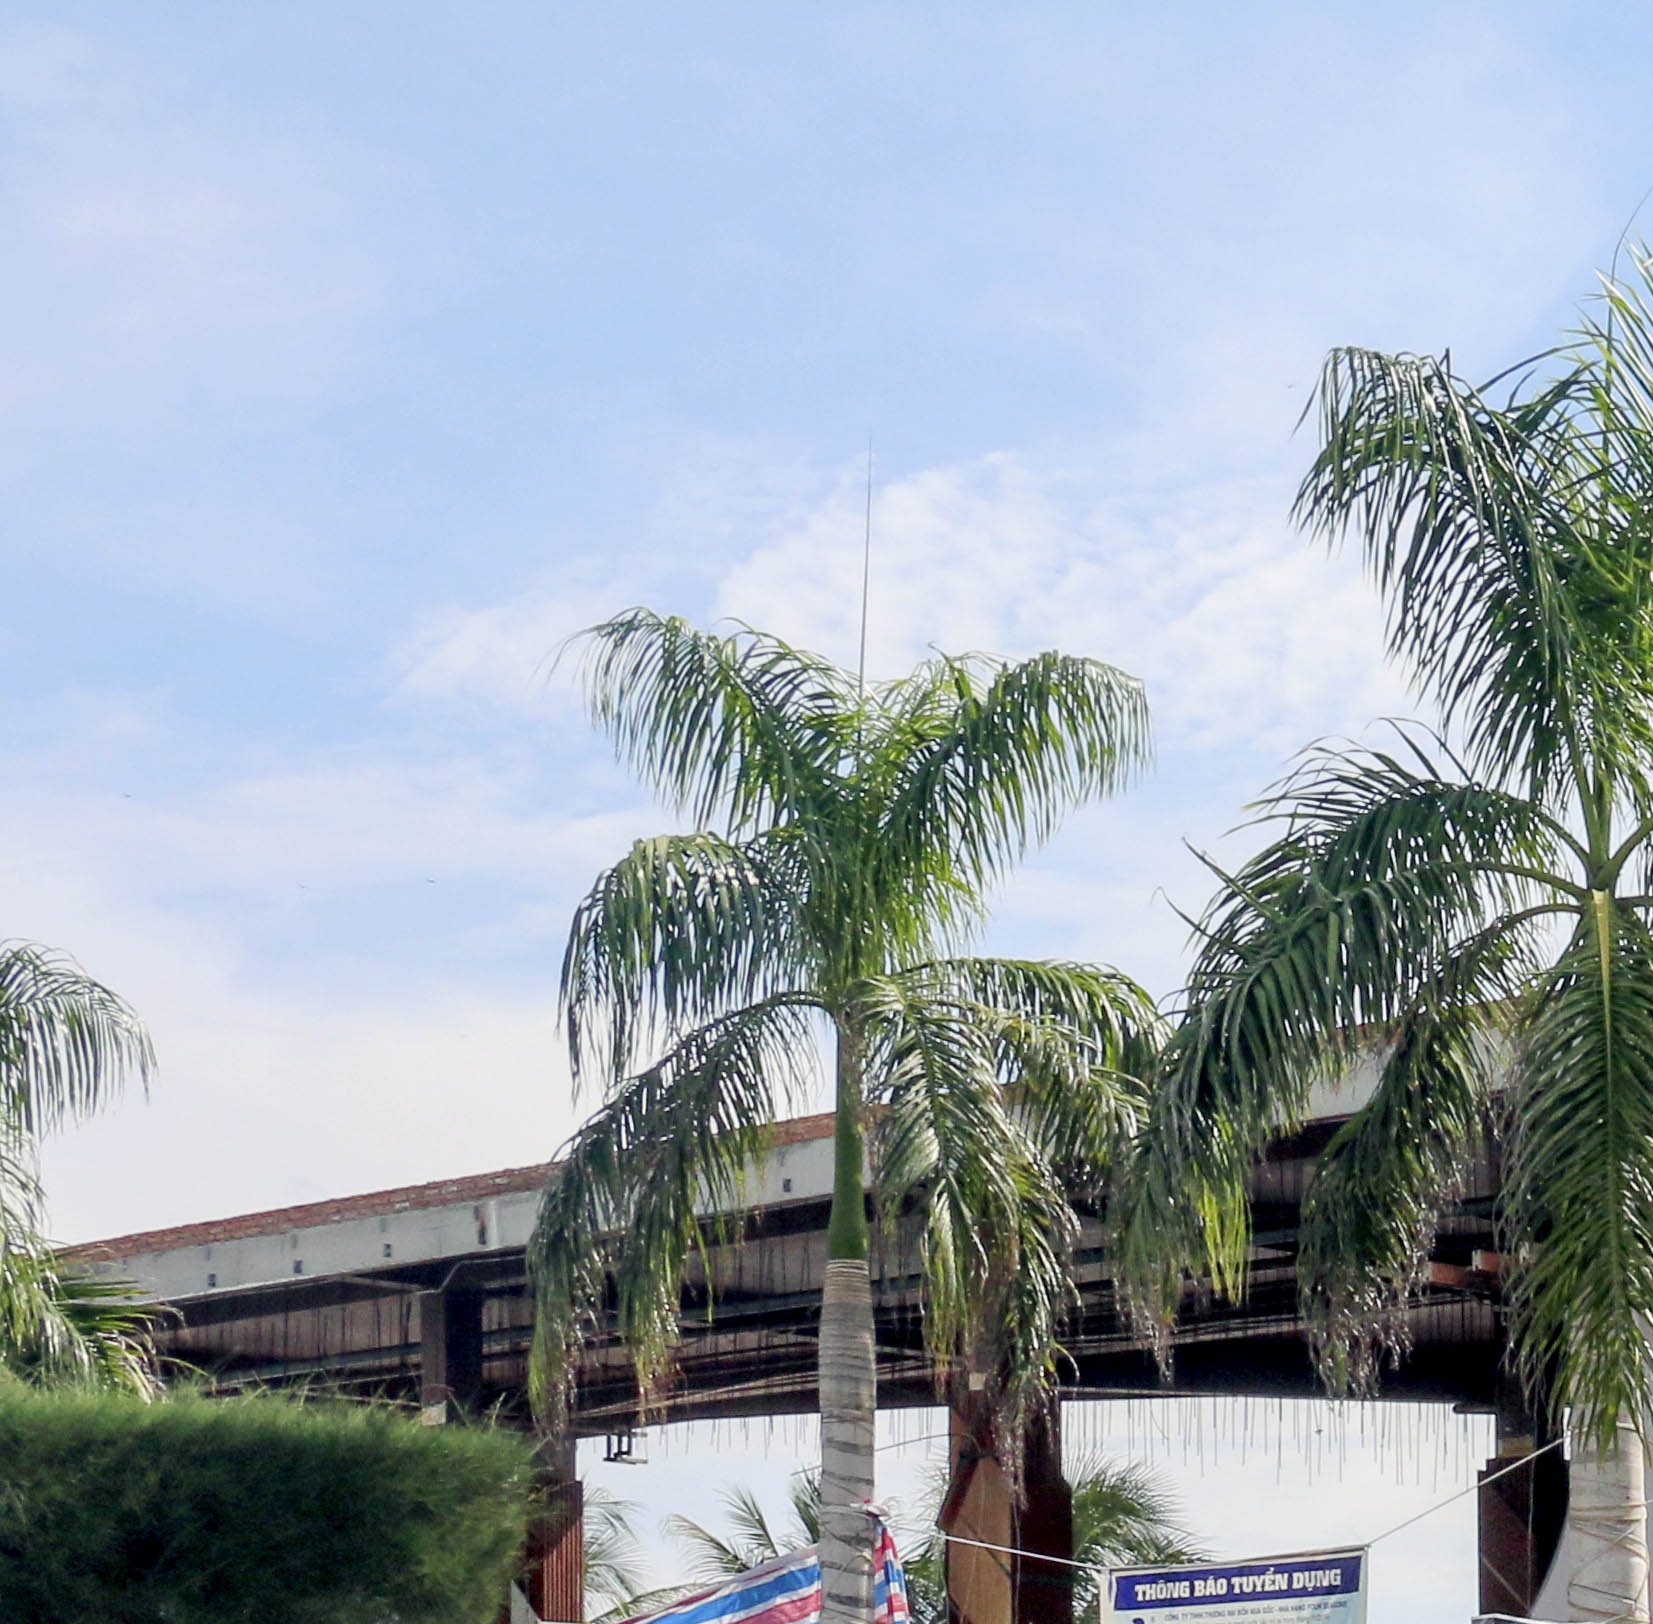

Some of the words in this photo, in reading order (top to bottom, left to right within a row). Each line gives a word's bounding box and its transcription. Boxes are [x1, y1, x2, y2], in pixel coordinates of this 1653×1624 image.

[1134, 1578, 1191, 1602] THÔNG
[1193, 1575, 1227, 1597] BÁO
[1231, 1567, 1288, 1594] TUYỂN
[1292, 1568, 1341, 1592] DỤNG
